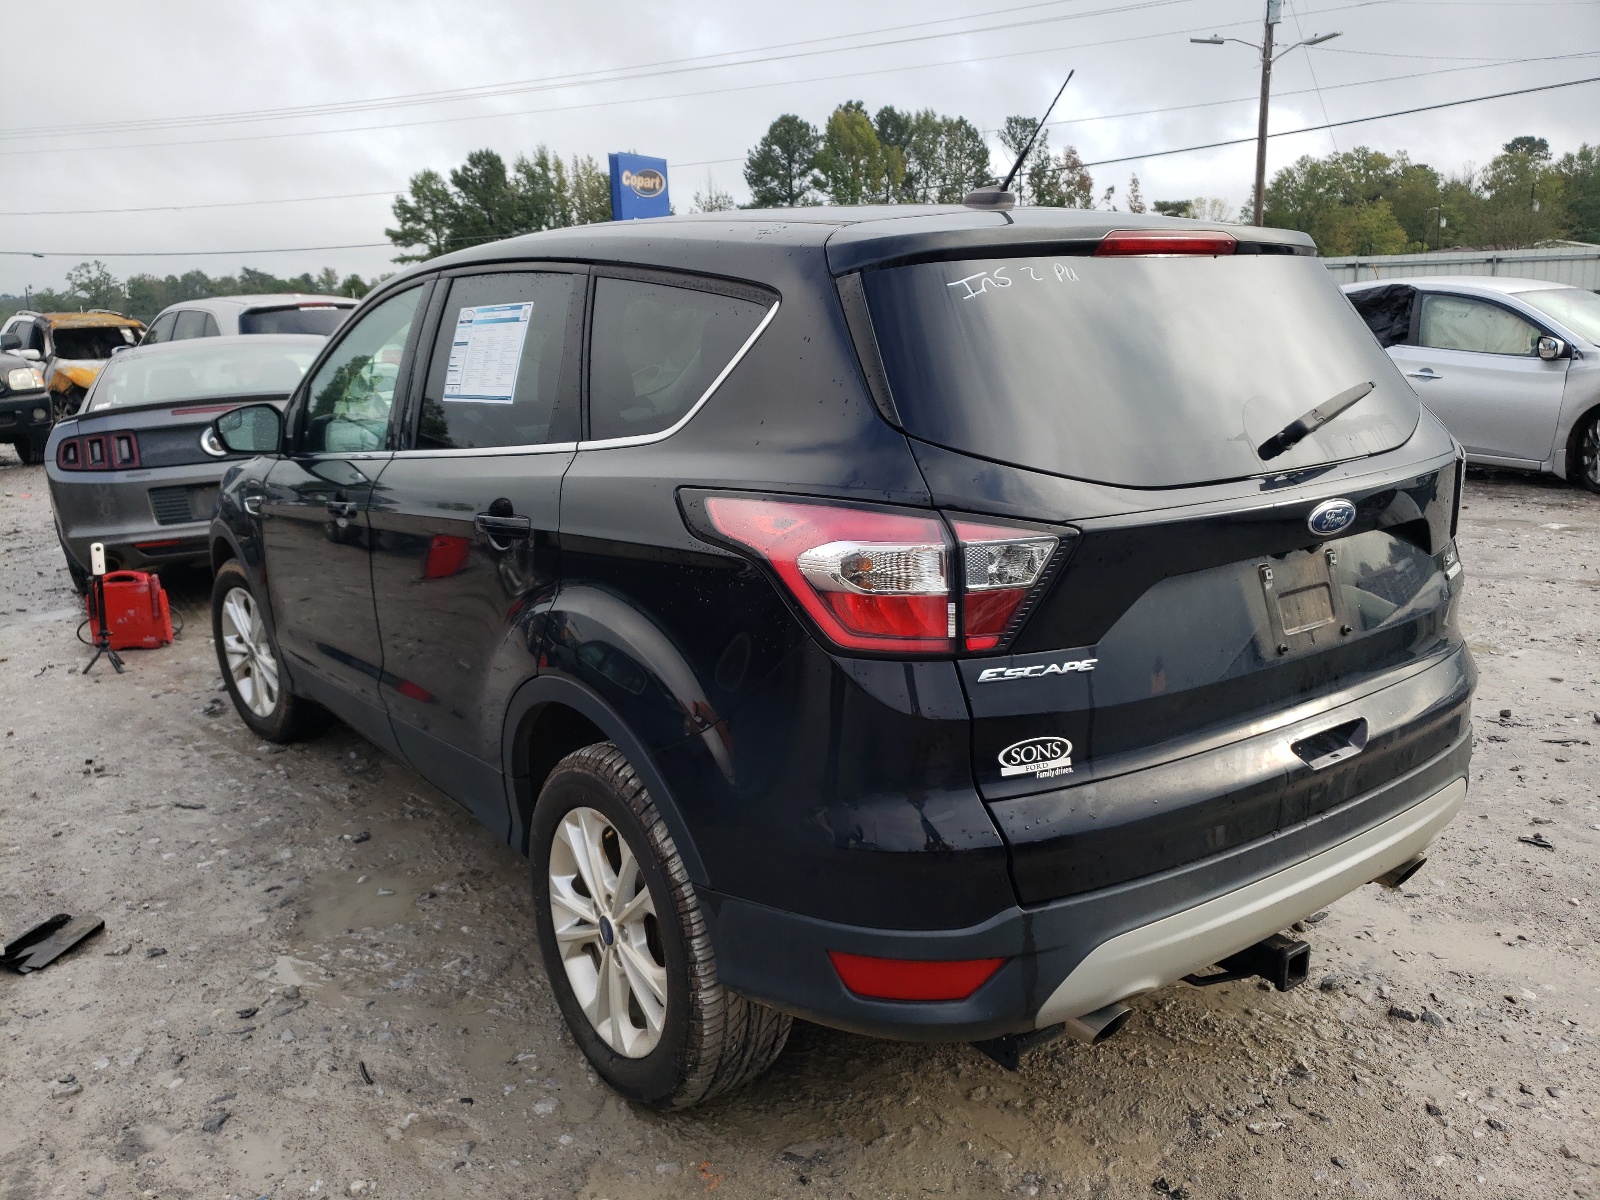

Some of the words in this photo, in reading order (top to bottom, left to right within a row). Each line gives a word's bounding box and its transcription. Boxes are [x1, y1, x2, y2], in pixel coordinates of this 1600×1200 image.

[622, 170, 660, 189] Copart
[1321, 508, 1349, 529] Ford
[978, 659, 1098, 682] ESCAPE
[1010, 741, 1061, 765] SONS
[1025, 762, 1049, 772] FORD
